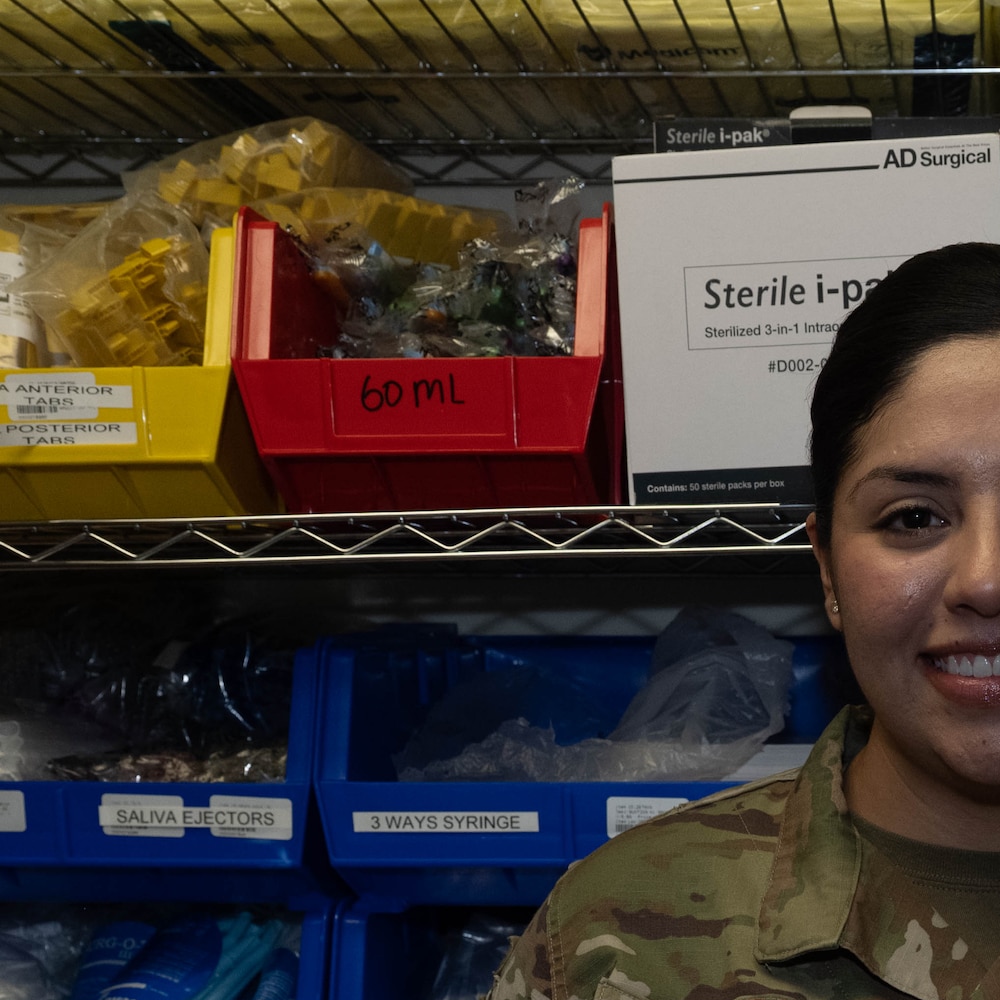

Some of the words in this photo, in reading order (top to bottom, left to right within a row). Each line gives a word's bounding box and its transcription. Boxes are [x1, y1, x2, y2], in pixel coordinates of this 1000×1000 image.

[667, 128, 716, 144] Sterile
[883, 149, 917, 169] AD
[920, 149, 992, 170] Surgical
[703, 275, 806, 310] Sterile
[816, 271, 892, 309] i-pa
[704, 325, 761, 339] Sterilized
[764, 324, 799, 337] 3-in-1
[15, 384, 113, 395] ANTERIOR
[361, 376, 403, 412] 60
[6, 423, 121, 433] POSTERIOR
[22, 436, 75, 445] TABS
[646, 483, 688, 494] Contains:
[689, 482, 700, 492] 50
[701, 481, 731, 492] sterile
[732, 481, 753, 493] packs
[754, 480, 766, 491] per
[767, 479, 785, 490] box
[116, 809, 178, 825] SALIVA
[182, 810, 275, 826] EJECTORS
[370, 816, 381, 830] 3
[385, 816, 438, 829] WAYS
[442, 816, 521, 830] SYRINGE
